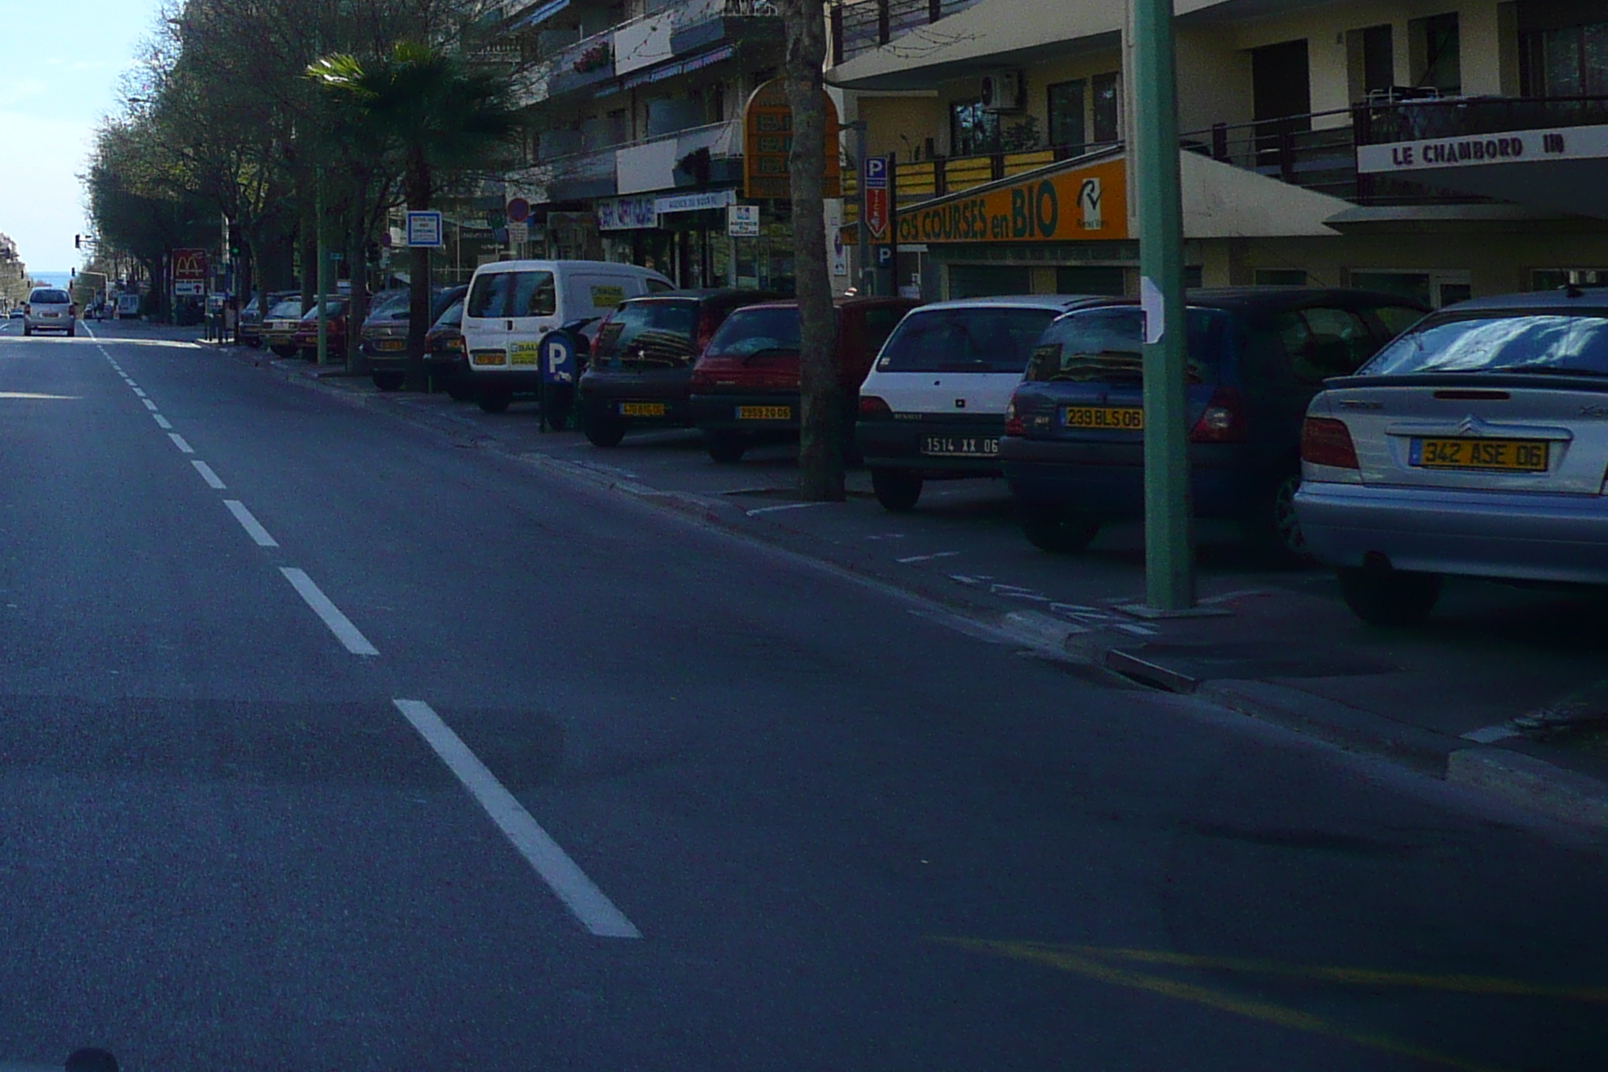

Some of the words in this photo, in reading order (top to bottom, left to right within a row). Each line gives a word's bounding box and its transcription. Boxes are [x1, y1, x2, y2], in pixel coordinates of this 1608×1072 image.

[1393, 146, 1413, 165] LE
[1423, 137, 1523, 164] CHAMBORD
[869, 159, 883, 177] P
[897, 213, 919, 240] OS
[923, 199, 987, 239] COURSES
[992, 214, 1010, 239] en
[1013, 179, 1058, 238] BIO
[879, 247, 892, 264] P
[548, 342, 567, 374] P
[1068, 409, 1093, 425] 239
[1094, 409, 1120, 426] BLS
[1122, 410, 1141, 427] 06
[927, 438, 955, 453] 1514
[962, 438, 976, 453] XX
[983, 438, 999, 454] 06
[1426, 441, 1460, 463] 342
[1470, 443, 1506, 465] ASE
[1515, 444, 1542, 467] 06
